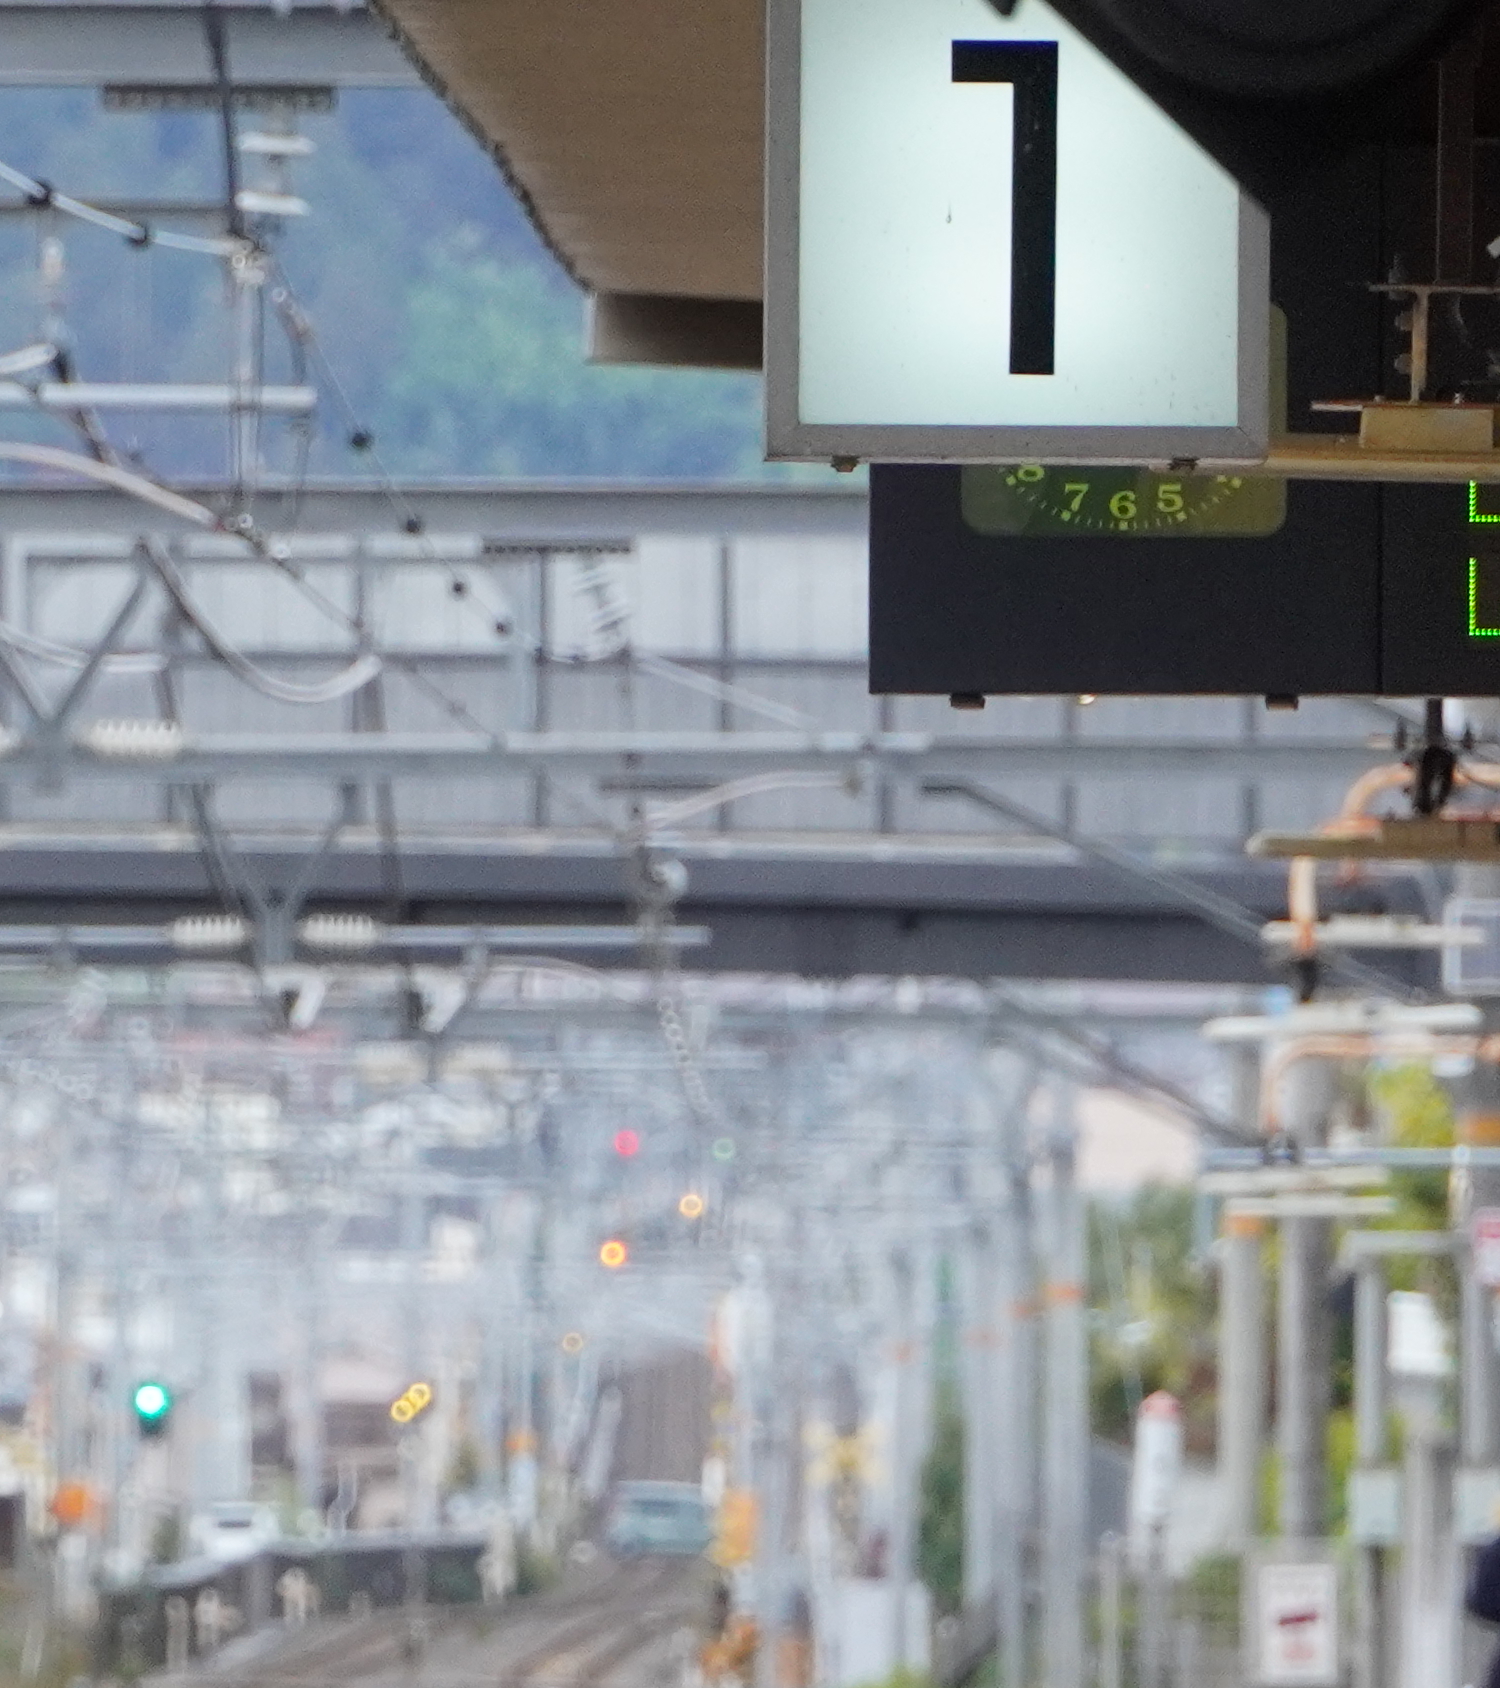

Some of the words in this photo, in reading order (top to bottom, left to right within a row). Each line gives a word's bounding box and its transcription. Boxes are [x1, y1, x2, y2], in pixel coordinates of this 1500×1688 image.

[950, 39, 1060, 376] 1
[1064, 482, 1090, 513] 7
[1108, 489, 1138, 520] 6
[1156, 483, 1185, 513] 5
